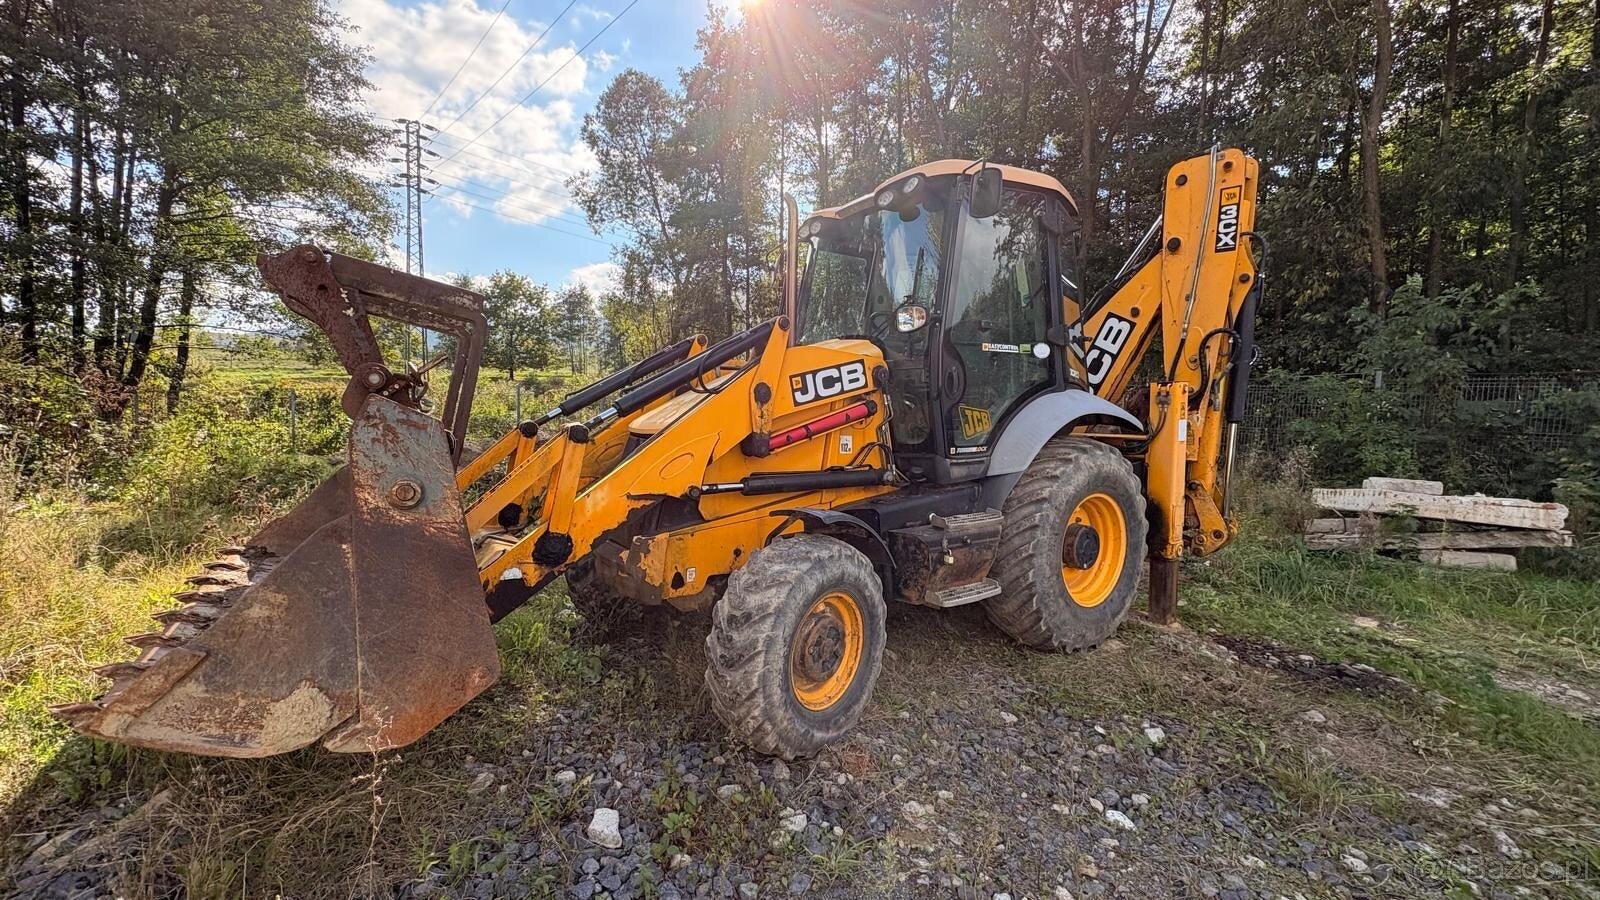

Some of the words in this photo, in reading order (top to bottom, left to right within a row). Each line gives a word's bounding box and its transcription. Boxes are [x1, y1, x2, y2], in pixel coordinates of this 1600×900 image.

[1216, 204, 1238, 247] 3CX
[794, 362, 866, 403] JCB
[964, 409, 990, 435] JCB
